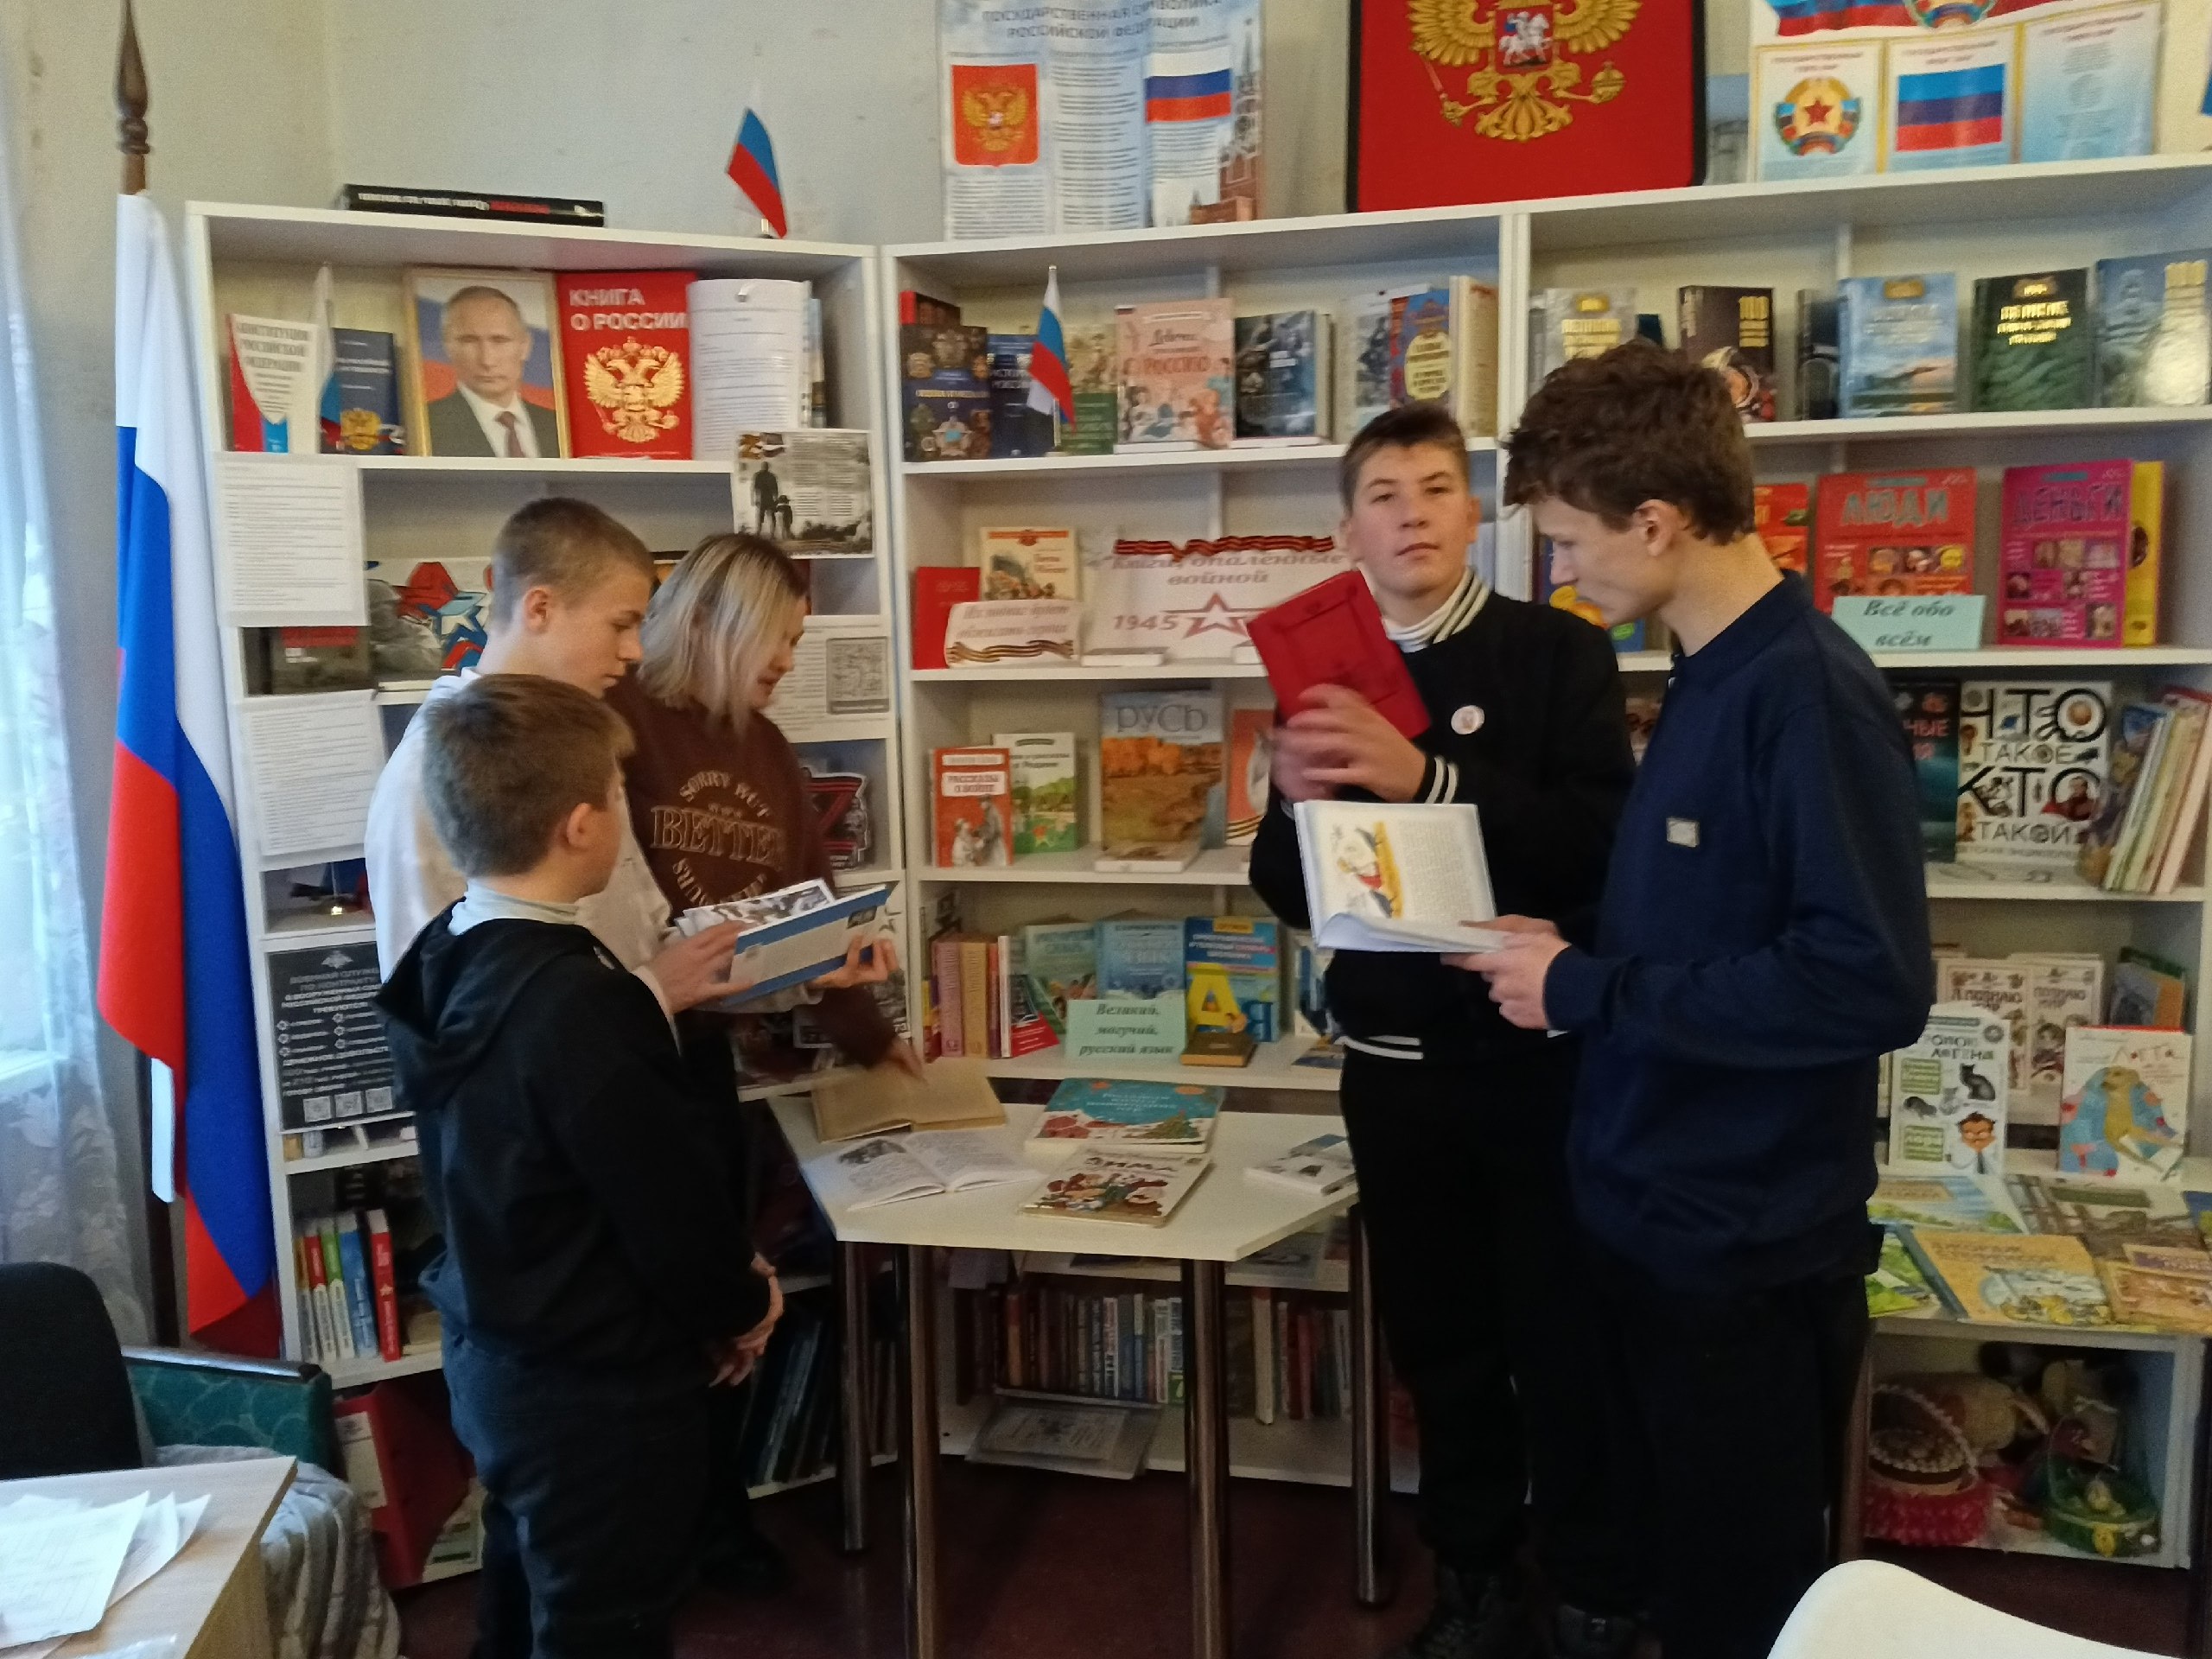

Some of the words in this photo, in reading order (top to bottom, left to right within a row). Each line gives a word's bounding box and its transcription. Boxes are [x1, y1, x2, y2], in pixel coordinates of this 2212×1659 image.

[569, 289, 645, 307] КНИГА
[570, 313, 592, 331] О
[593, 312, 690, 331] РОССИИ
[1840, 488, 1949, 529] ЛЮДИ
[1112, 614, 1179, 632] 1945
[1960, 689, 2107, 742] ЧТО
[1980, 742, 2075, 765] ТАКОЕ
[1958, 766, 2101, 821] КТО
